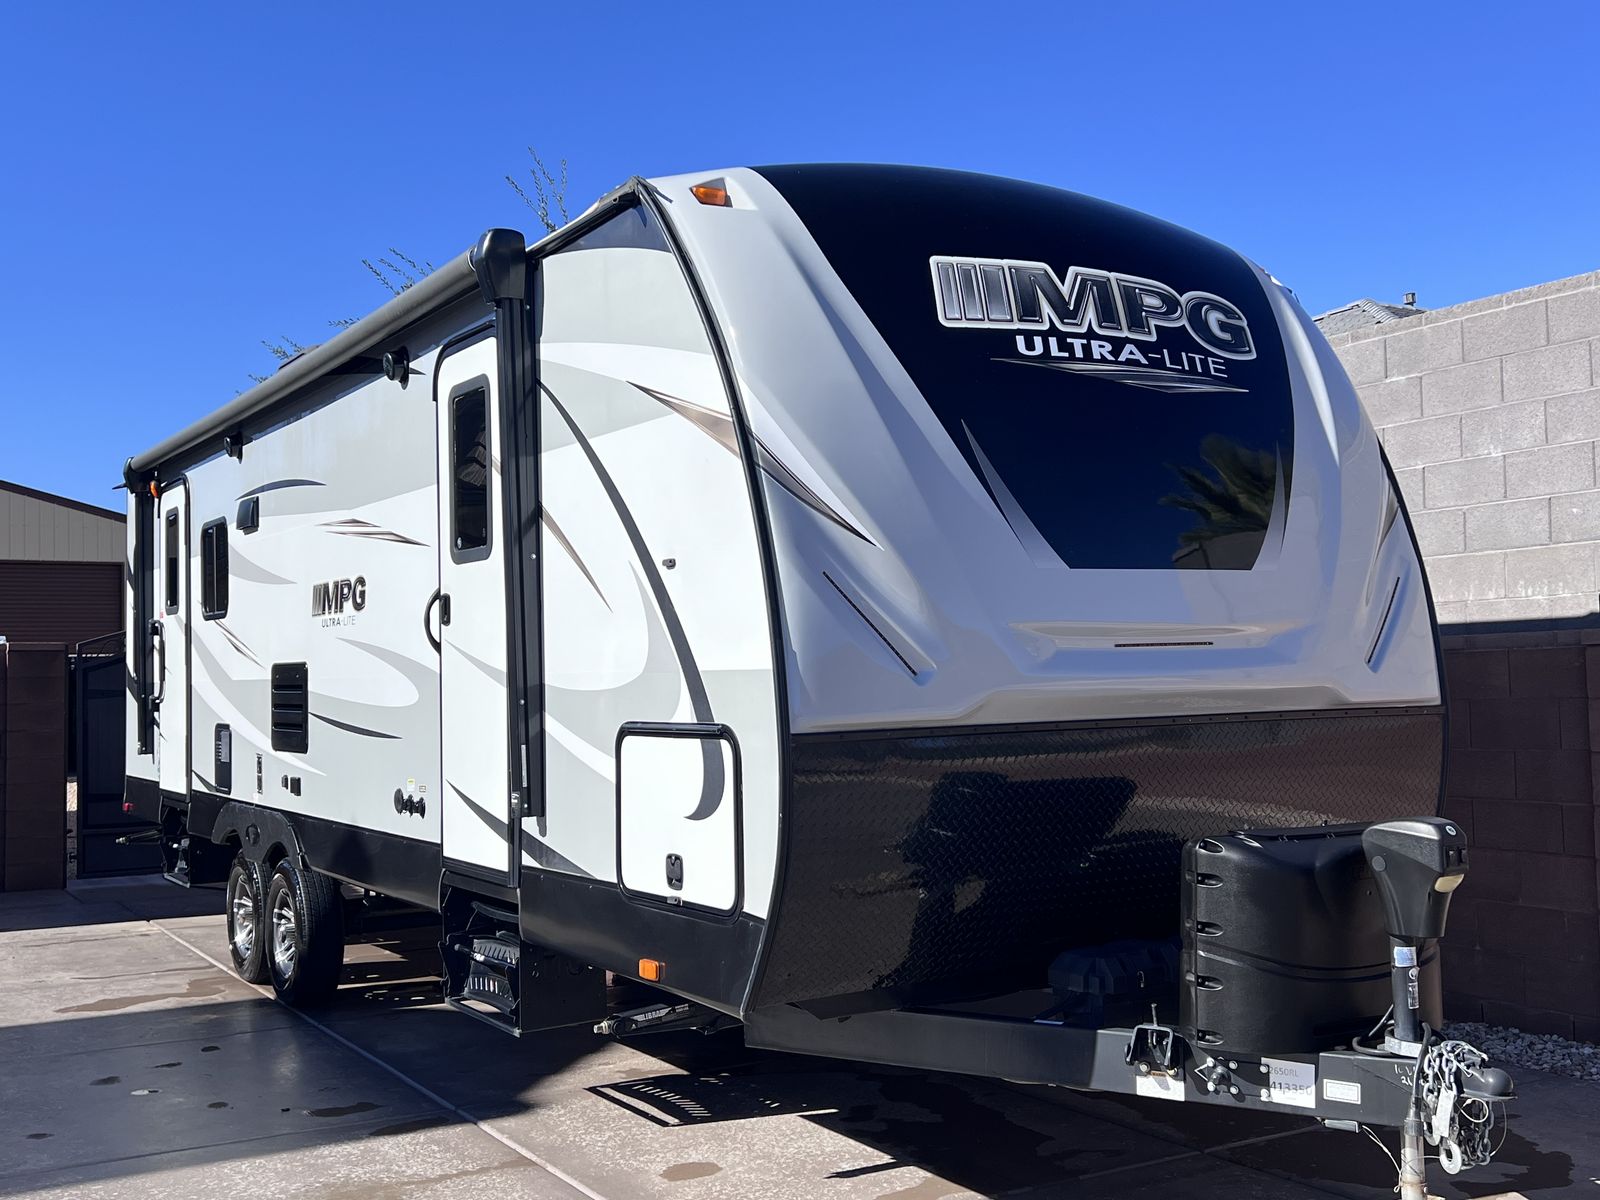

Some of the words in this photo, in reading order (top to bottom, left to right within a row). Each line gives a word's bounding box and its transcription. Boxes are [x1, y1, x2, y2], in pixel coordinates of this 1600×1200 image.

[1008, 258, 1257, 360] MPG
[1015, 335, 1228, 378] ULTRA-LITE
[321, 575, 366, 615] MPG
[321, 615, 356, 628] ULTRA-LITE
[1269, 1066, 1299, 1078] 2650RL
